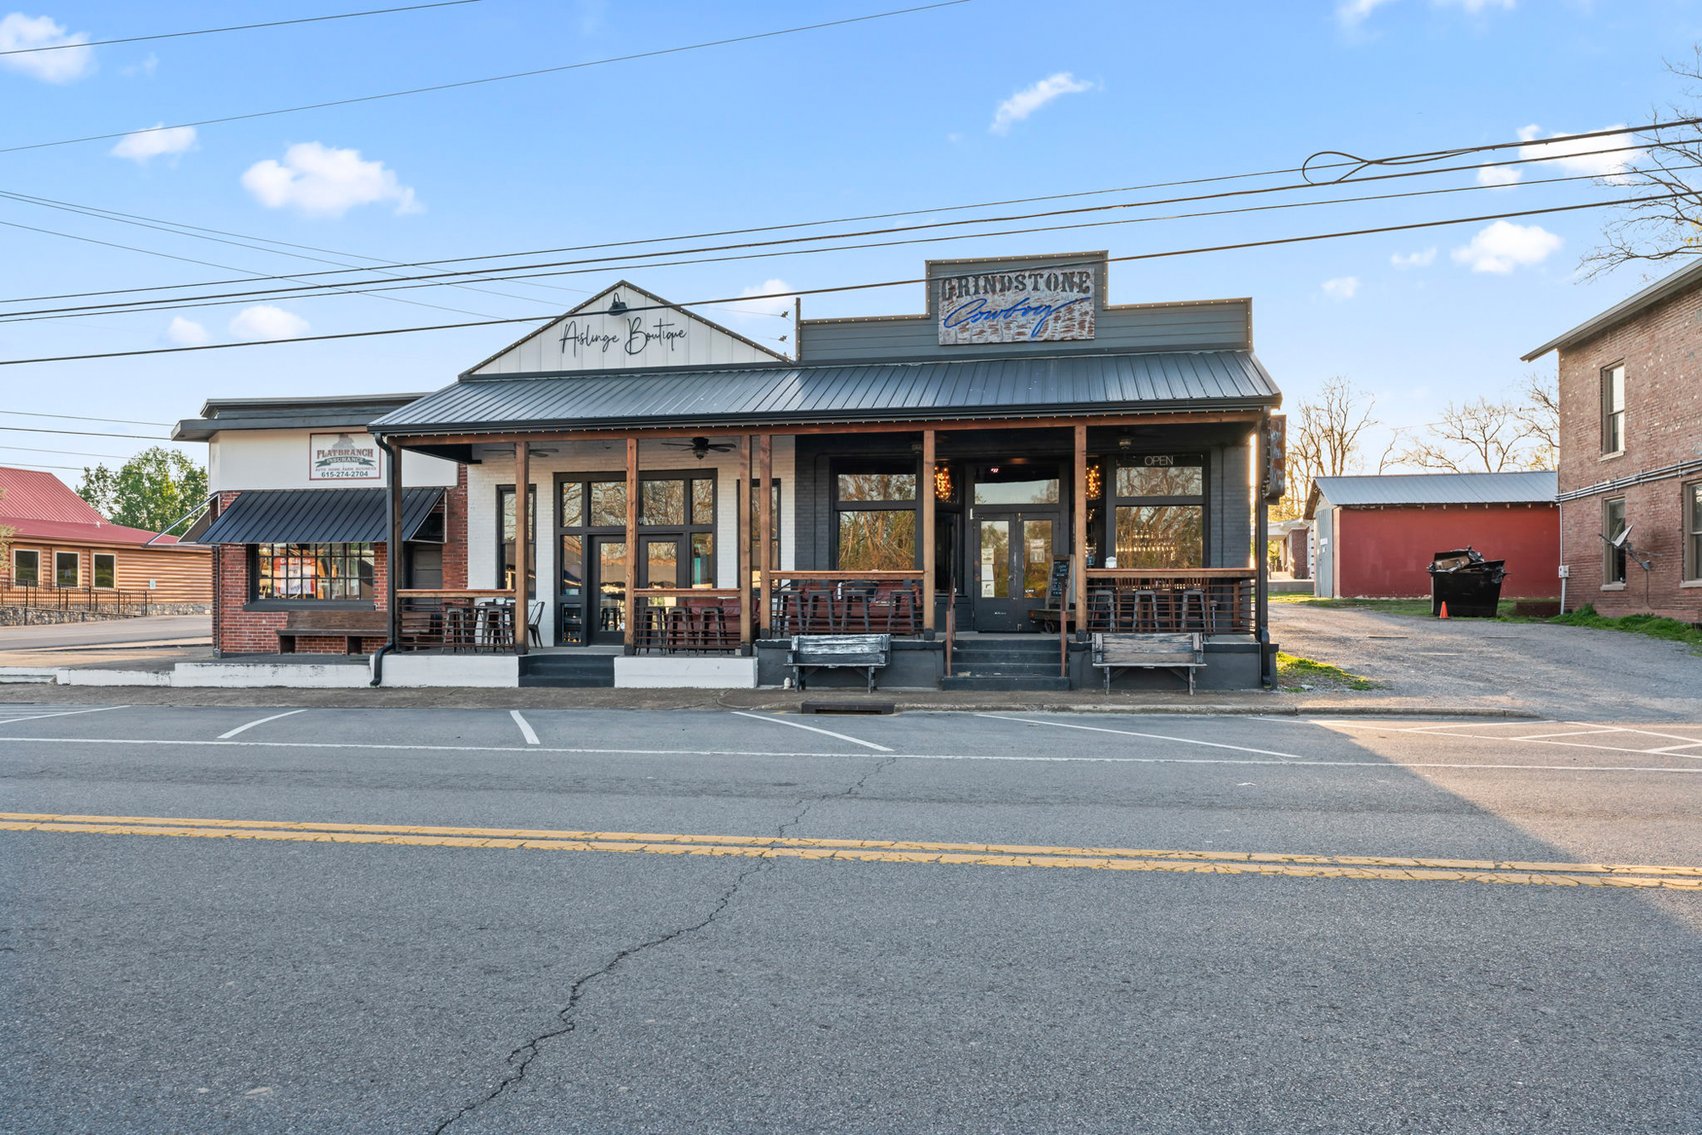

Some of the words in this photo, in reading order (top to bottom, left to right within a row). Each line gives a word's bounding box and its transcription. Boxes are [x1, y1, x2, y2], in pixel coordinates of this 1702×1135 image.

[941, 271, 1091, 300] GRINDSTONE
[943, 296, 1091, 339] Cowboy
[624, 316, 688, 356] Boutique
[1144, 455, 1174, 466] OPEN
